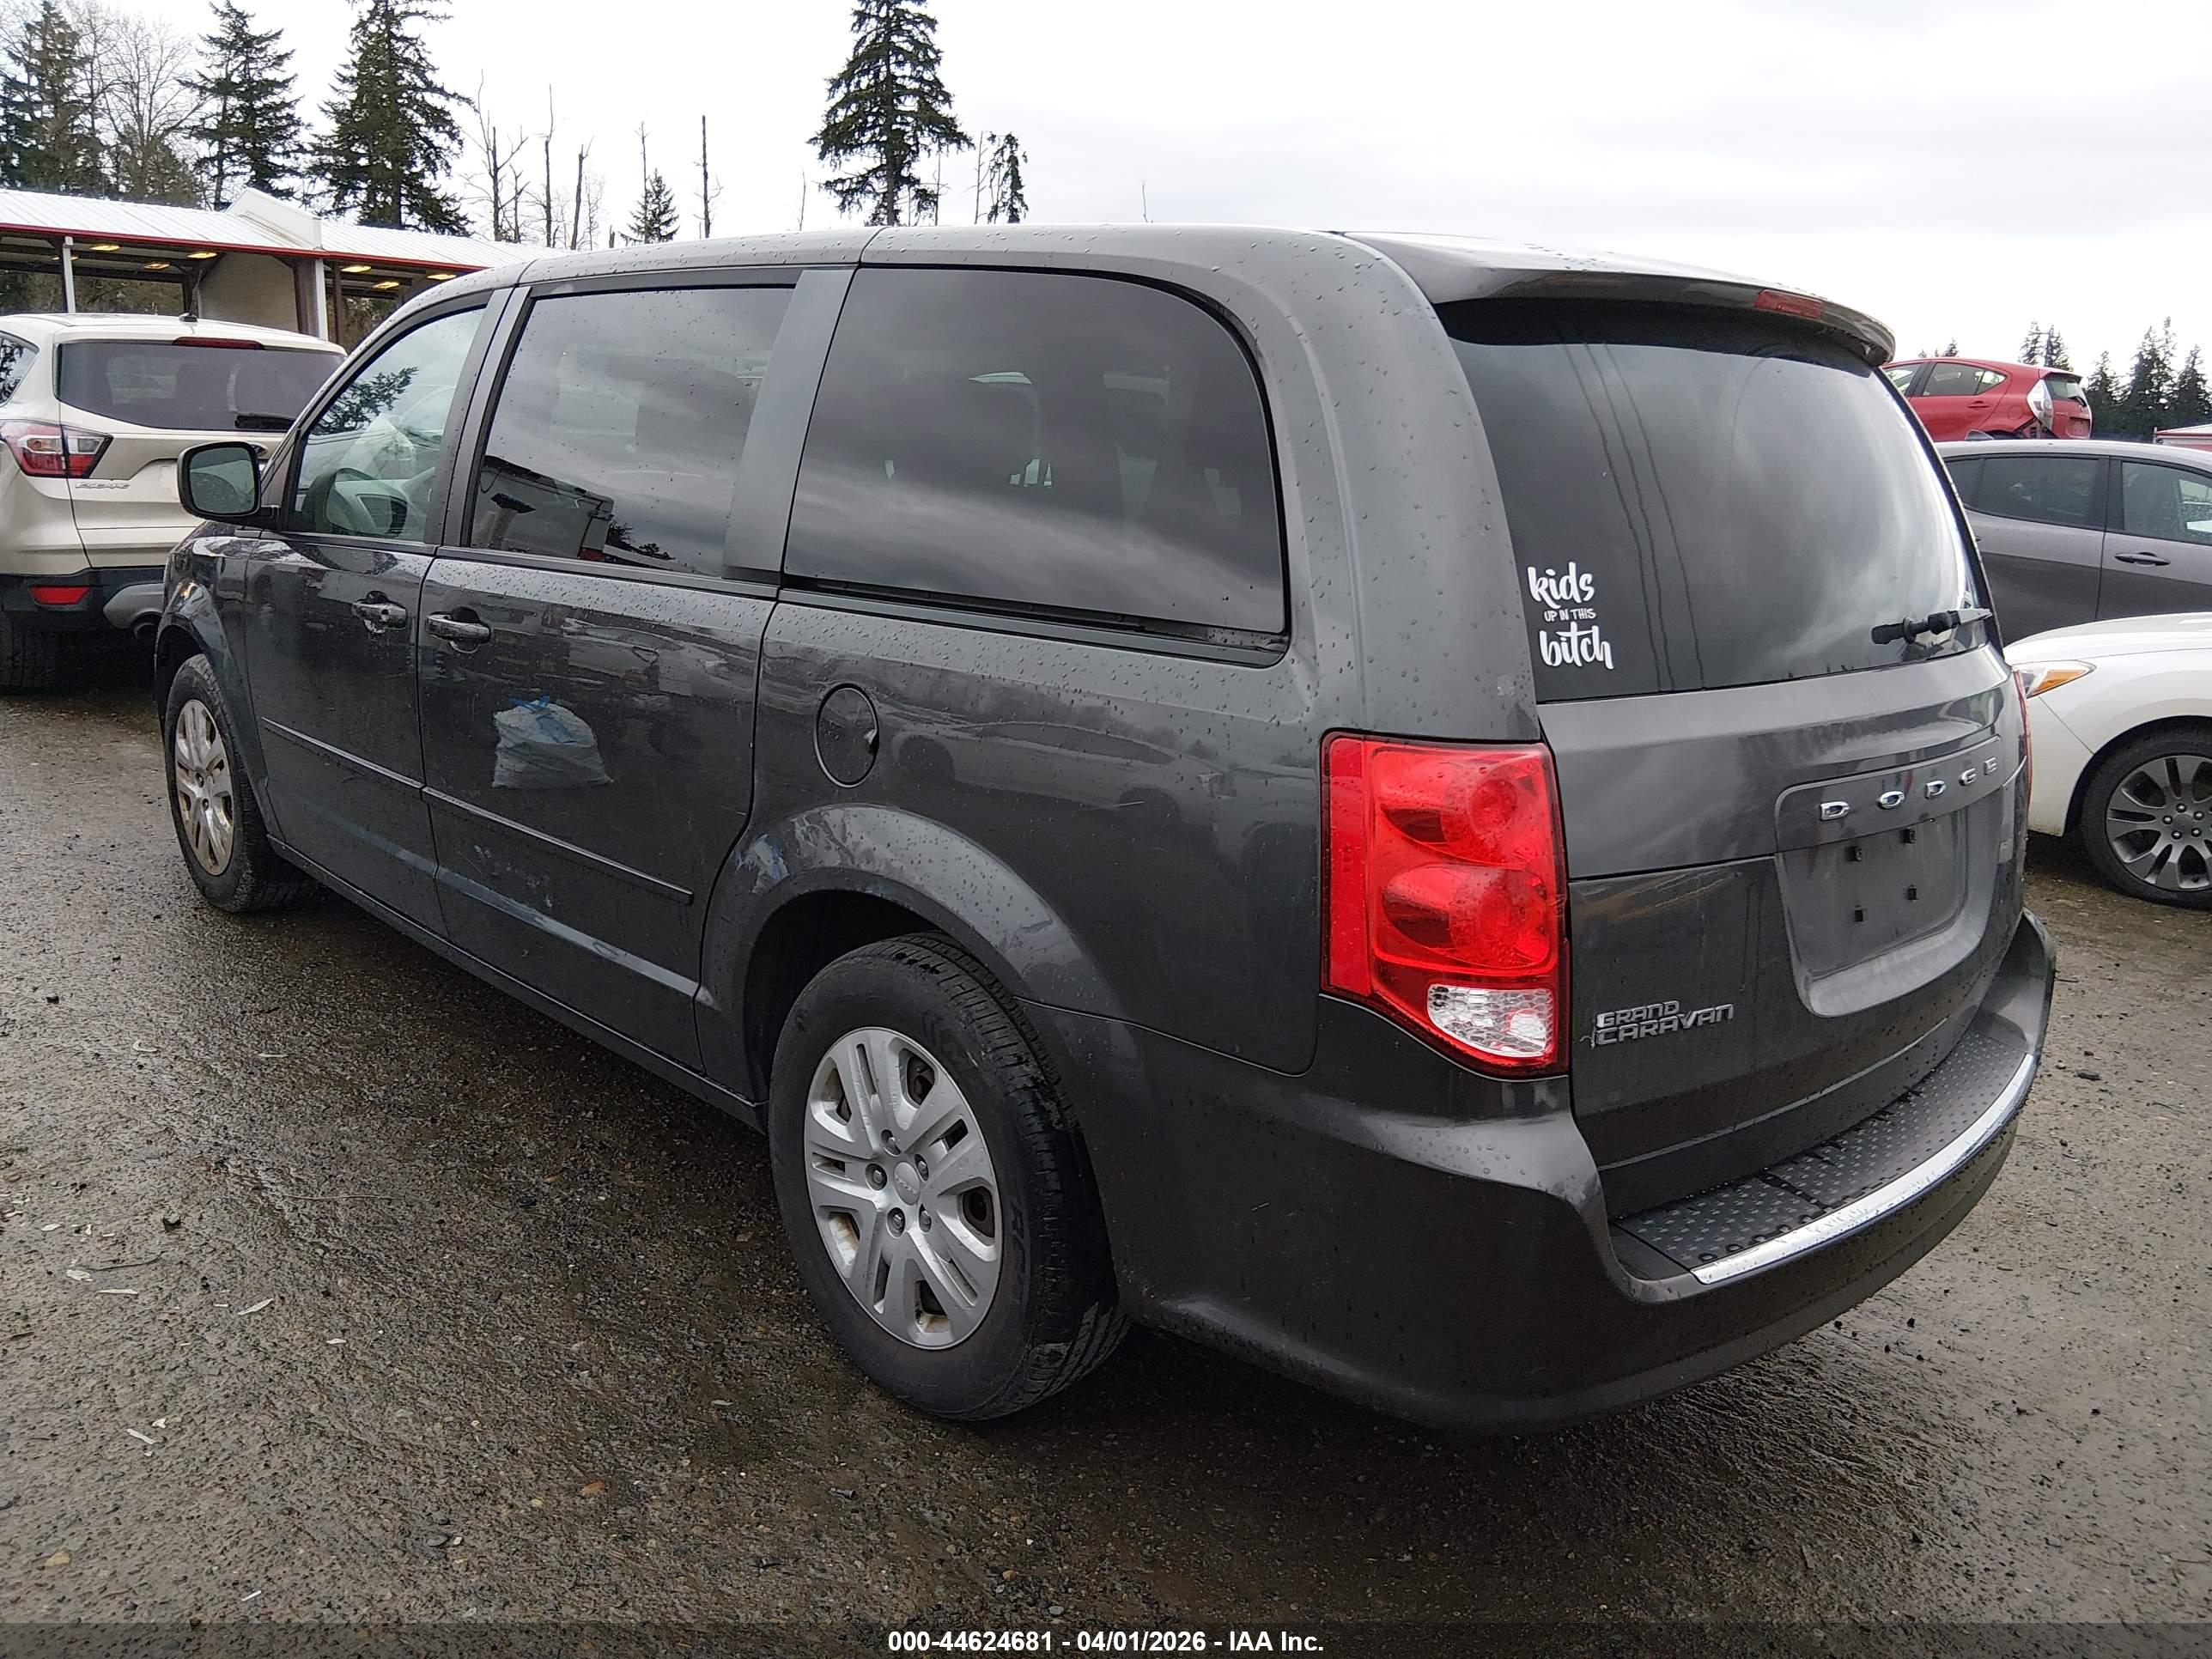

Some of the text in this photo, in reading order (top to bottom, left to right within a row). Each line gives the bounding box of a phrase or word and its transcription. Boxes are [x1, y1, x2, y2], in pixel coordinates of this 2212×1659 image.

[1527, 562, 1595, 610] kids
[1544, 608, 1597, 622] UP IN THIS
[1539, 621, 1614, 670] bitch
[1820, 757, 1997, 822] DODGE
[1595, 1000, 1680, 1029] GRAND
[1595, 1003, 1734, 1046] CARAVAN
